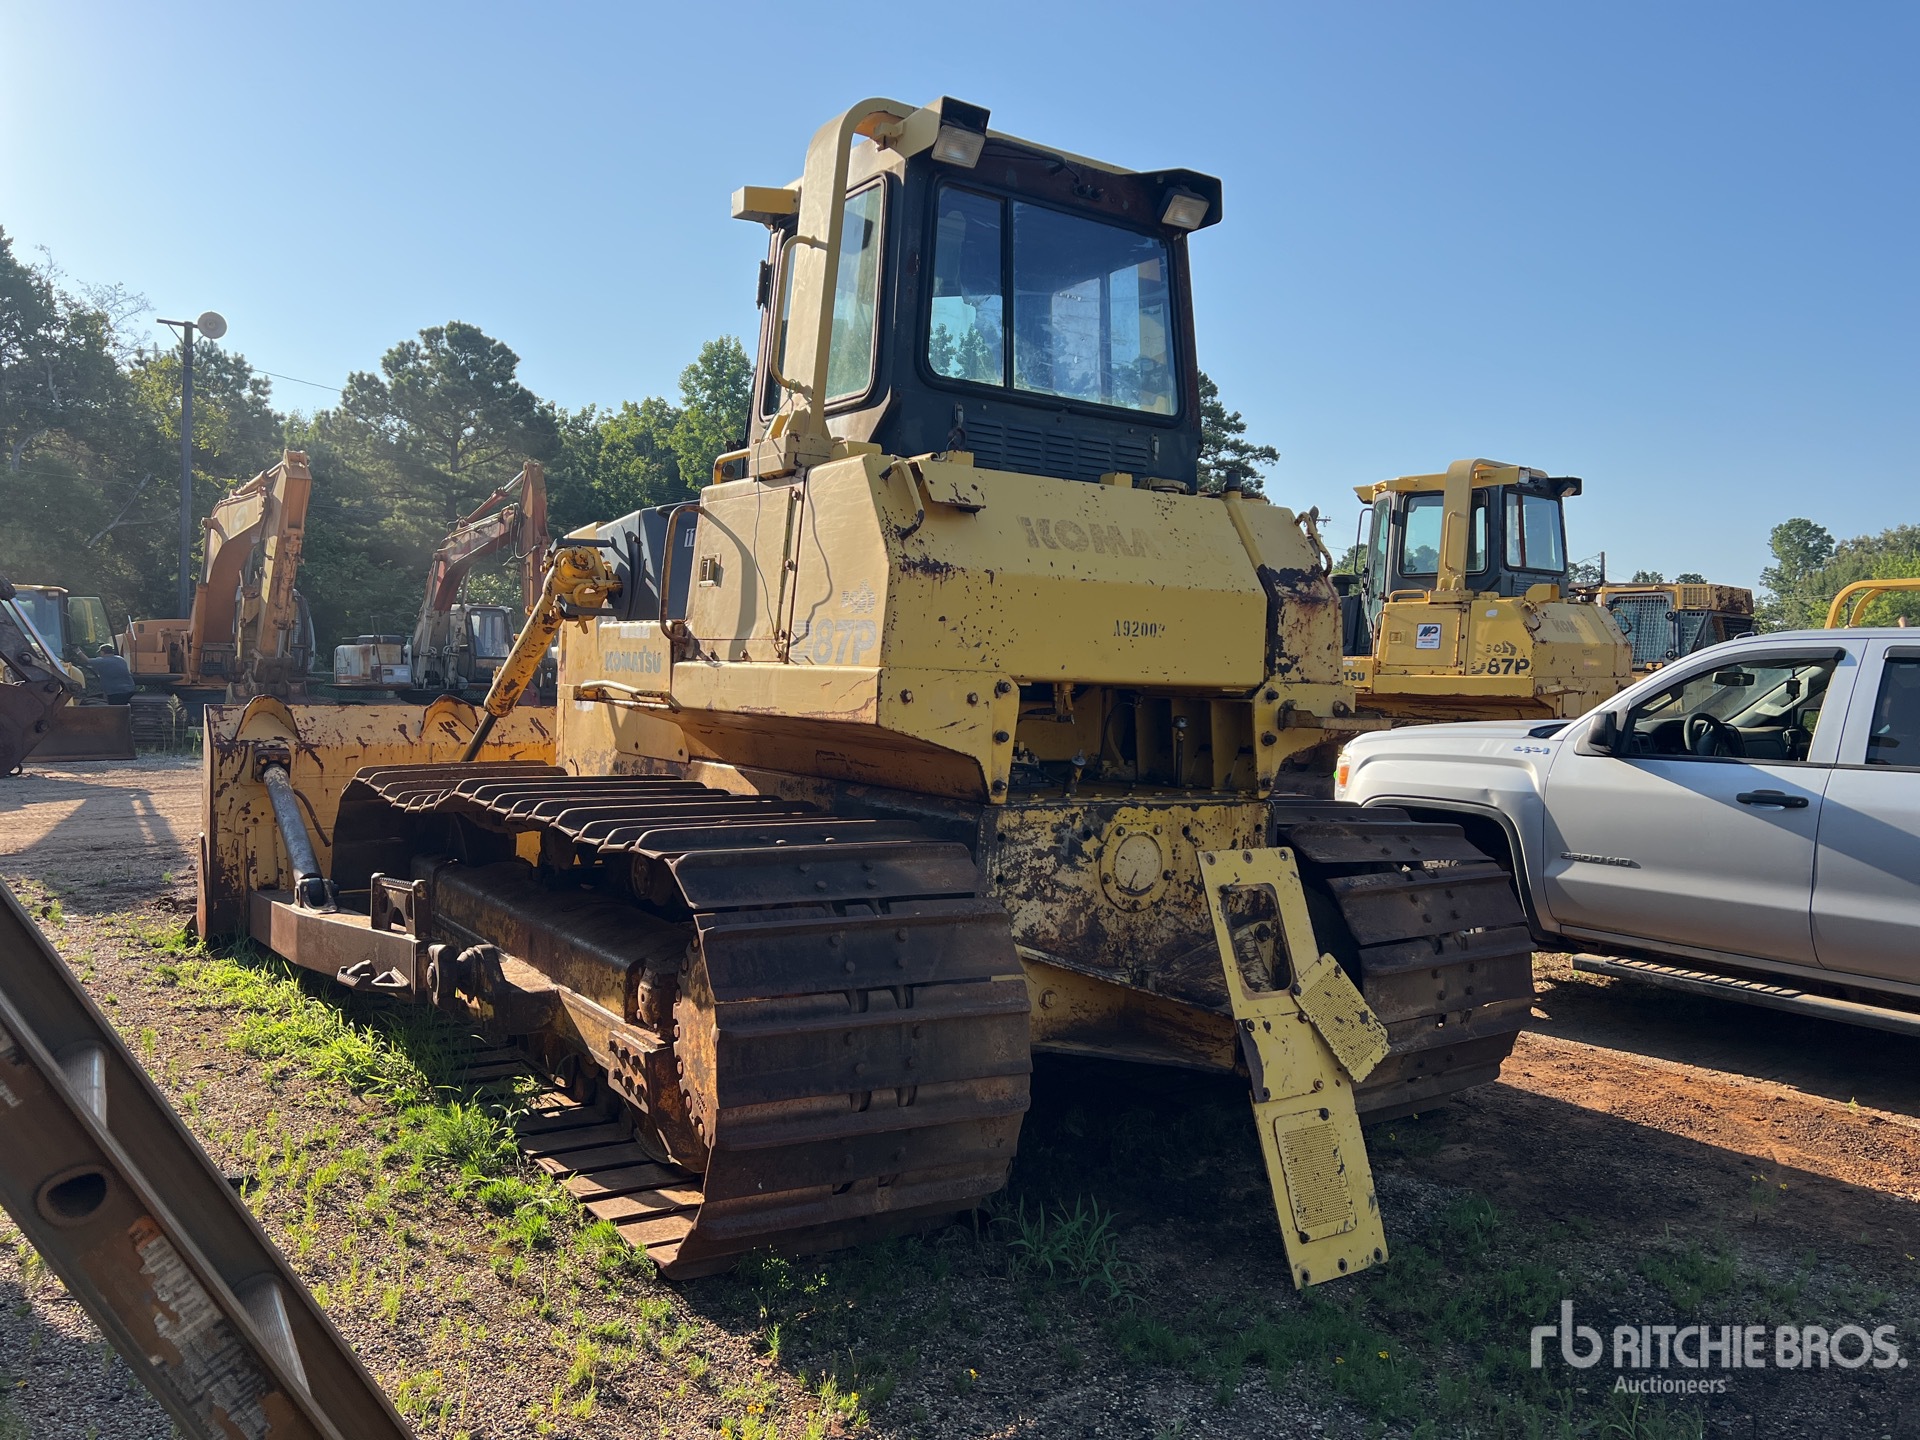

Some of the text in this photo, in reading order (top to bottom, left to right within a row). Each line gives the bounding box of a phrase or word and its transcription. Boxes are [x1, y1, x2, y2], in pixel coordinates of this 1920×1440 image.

[605, 647, 661, 673] KOMATSU
[1560, 851, 1631, 867] 2500 HD
